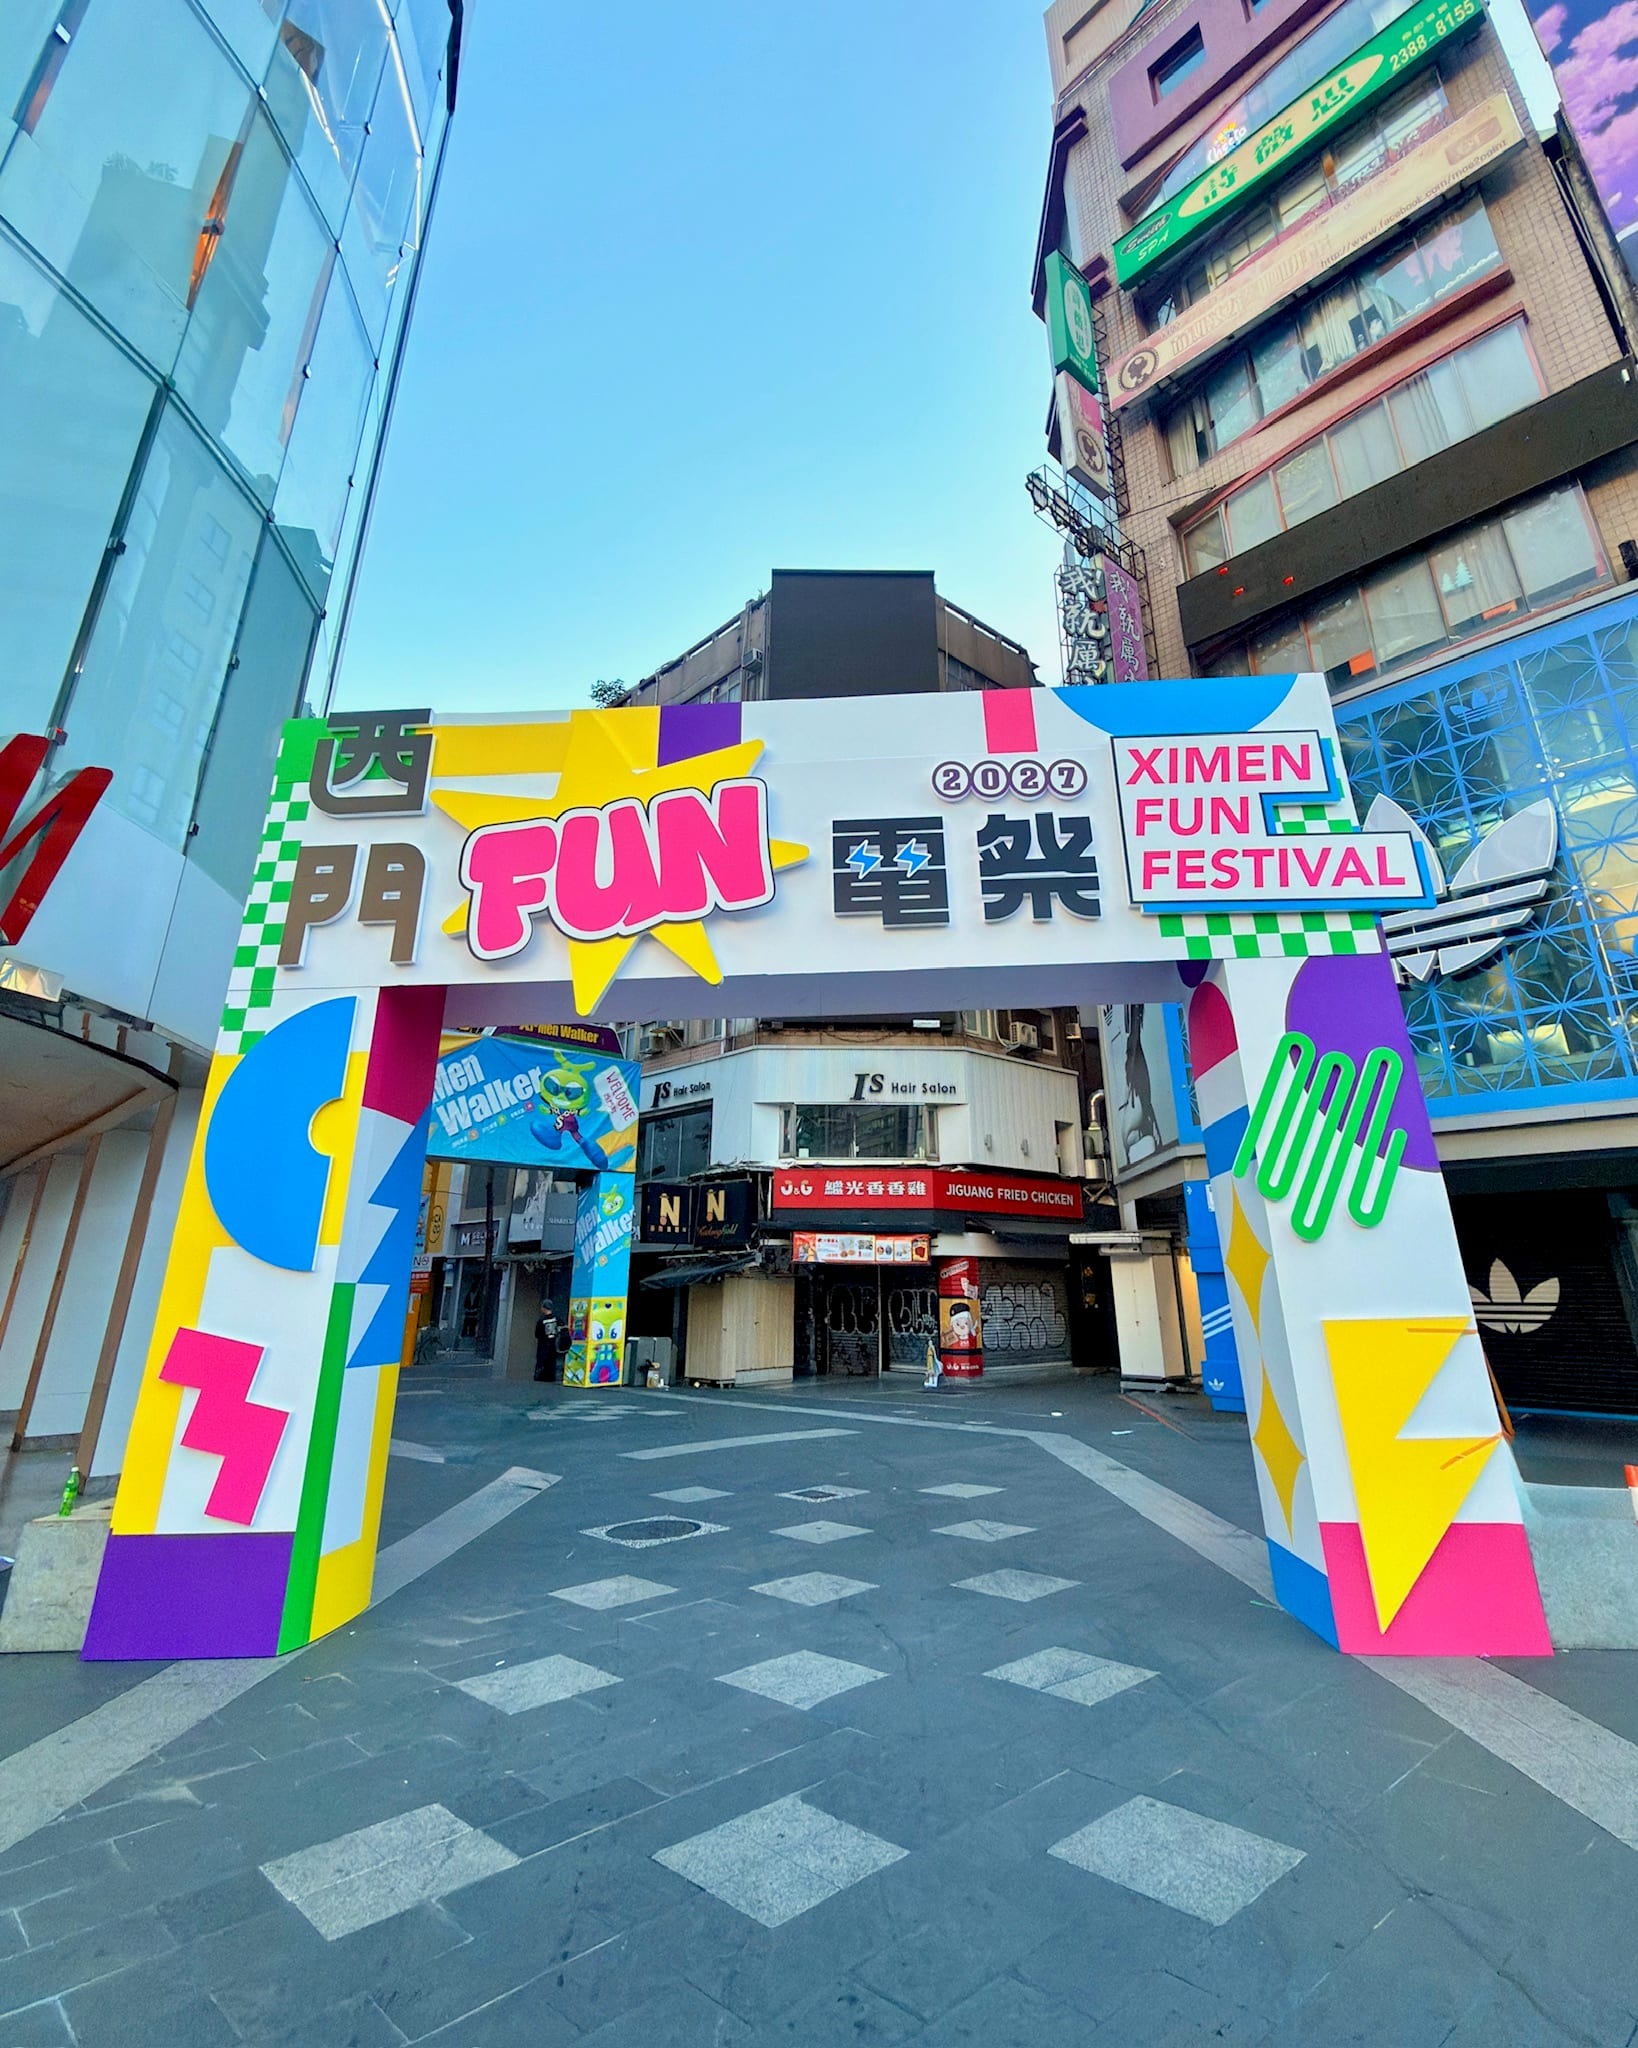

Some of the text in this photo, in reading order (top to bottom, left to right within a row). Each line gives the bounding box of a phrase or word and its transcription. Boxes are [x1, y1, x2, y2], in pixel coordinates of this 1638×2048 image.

[1389, 0, 1475, 71] 2388-8155
[1138, 229, 1169, 262] SPA
[938, 763, 1082, 795] 2027
[1126, 743, 1312, 786] XIMEN
[1134, 796, 1250, 838] FUN
[278, 708, 434, 967] 西門
[463, 780, 772, 958] FUN
[1141, 846, 1406, 891] FESTIVAL
[560, 1025, 599, 1043] Walker
[436, 1066, 542, 1137] Walker
[606, 1071, 636, 1121] WELCOME
[673, 1085, 688, 1096] Hair
[689, 1081, 711, 1093] Salon
[891, 1082, 917, 1094] Hair
[922, 1082, 957, 1094] Salon
[781, 1180, 927, 1196] J&G 繼光香香雞
[946, 1183, 1074, 1206] JIGUANG FRIED CHICKEN
